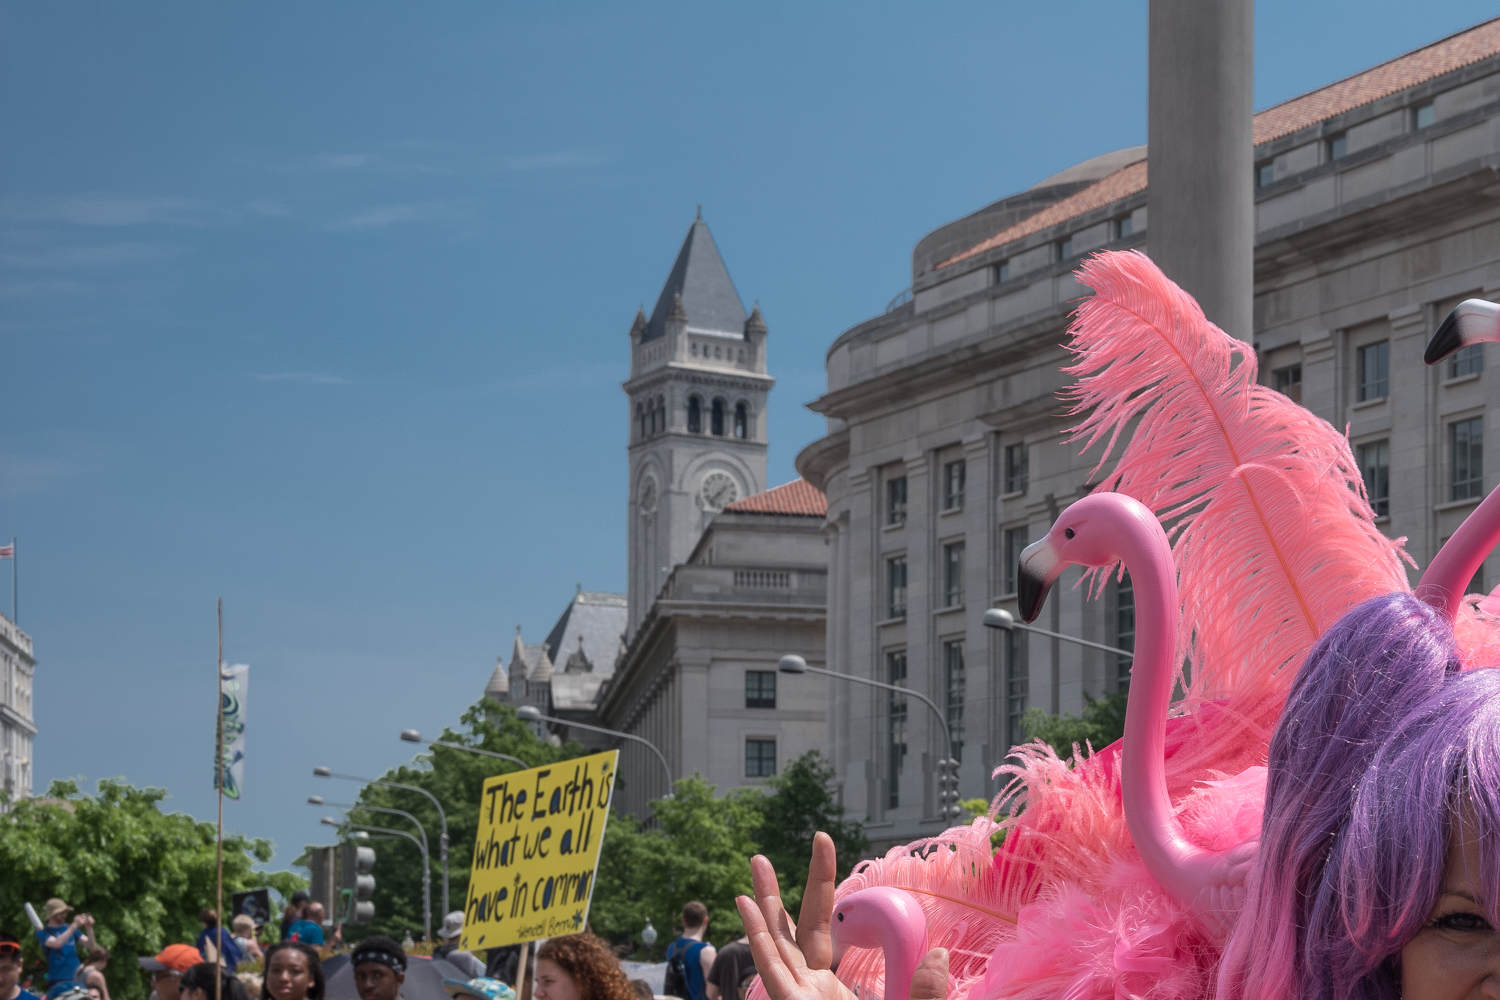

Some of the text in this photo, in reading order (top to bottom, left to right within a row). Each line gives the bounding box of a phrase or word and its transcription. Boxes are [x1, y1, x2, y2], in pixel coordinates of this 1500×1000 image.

[486, 762, 613, 825] The Earth is
[476, 809, 594, 870] what we all
[465, 869, 593, 927] have in common
